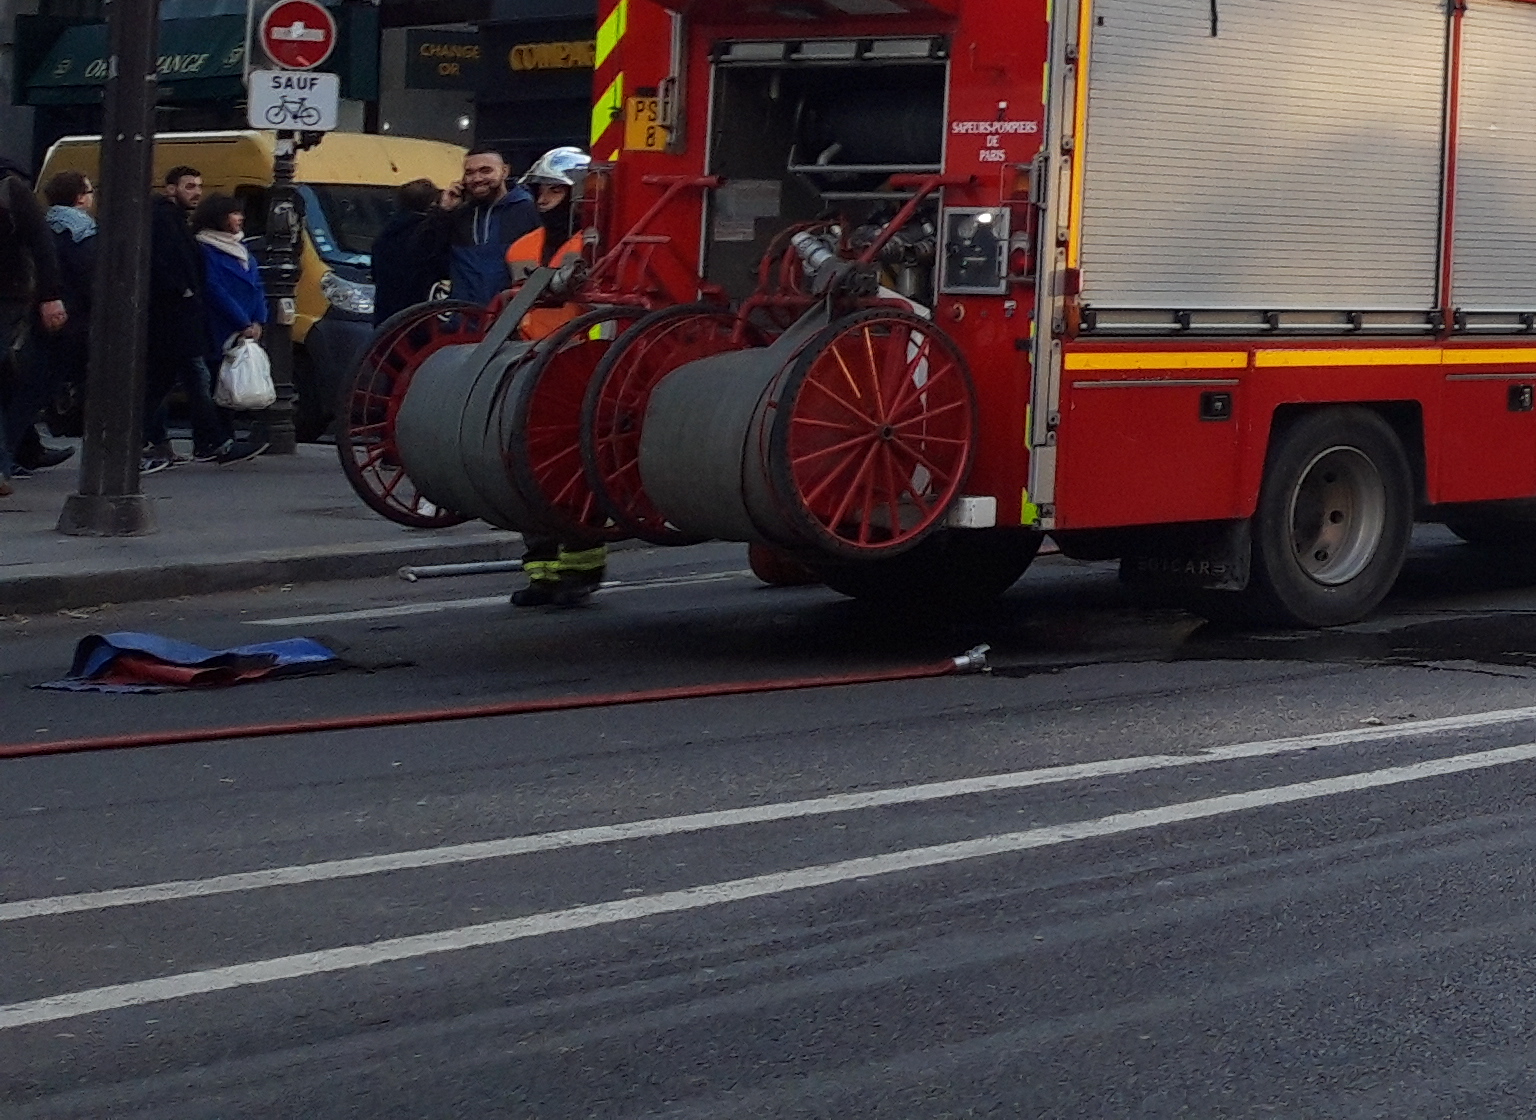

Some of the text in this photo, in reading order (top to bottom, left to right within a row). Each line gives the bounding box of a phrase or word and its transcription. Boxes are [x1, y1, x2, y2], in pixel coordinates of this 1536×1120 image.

[420, 43, 481, 59] CHANGE
[438, 62, 460, 76] OR
[271, 75, 319, 91] SAUF
[952, 121, 1037, 134] SAPEURS-POMPIERS
[645, 126, 657, 147] 8
[986, 135, 1000, 147] DE
[979, 149, 1006, 162] PARIS
